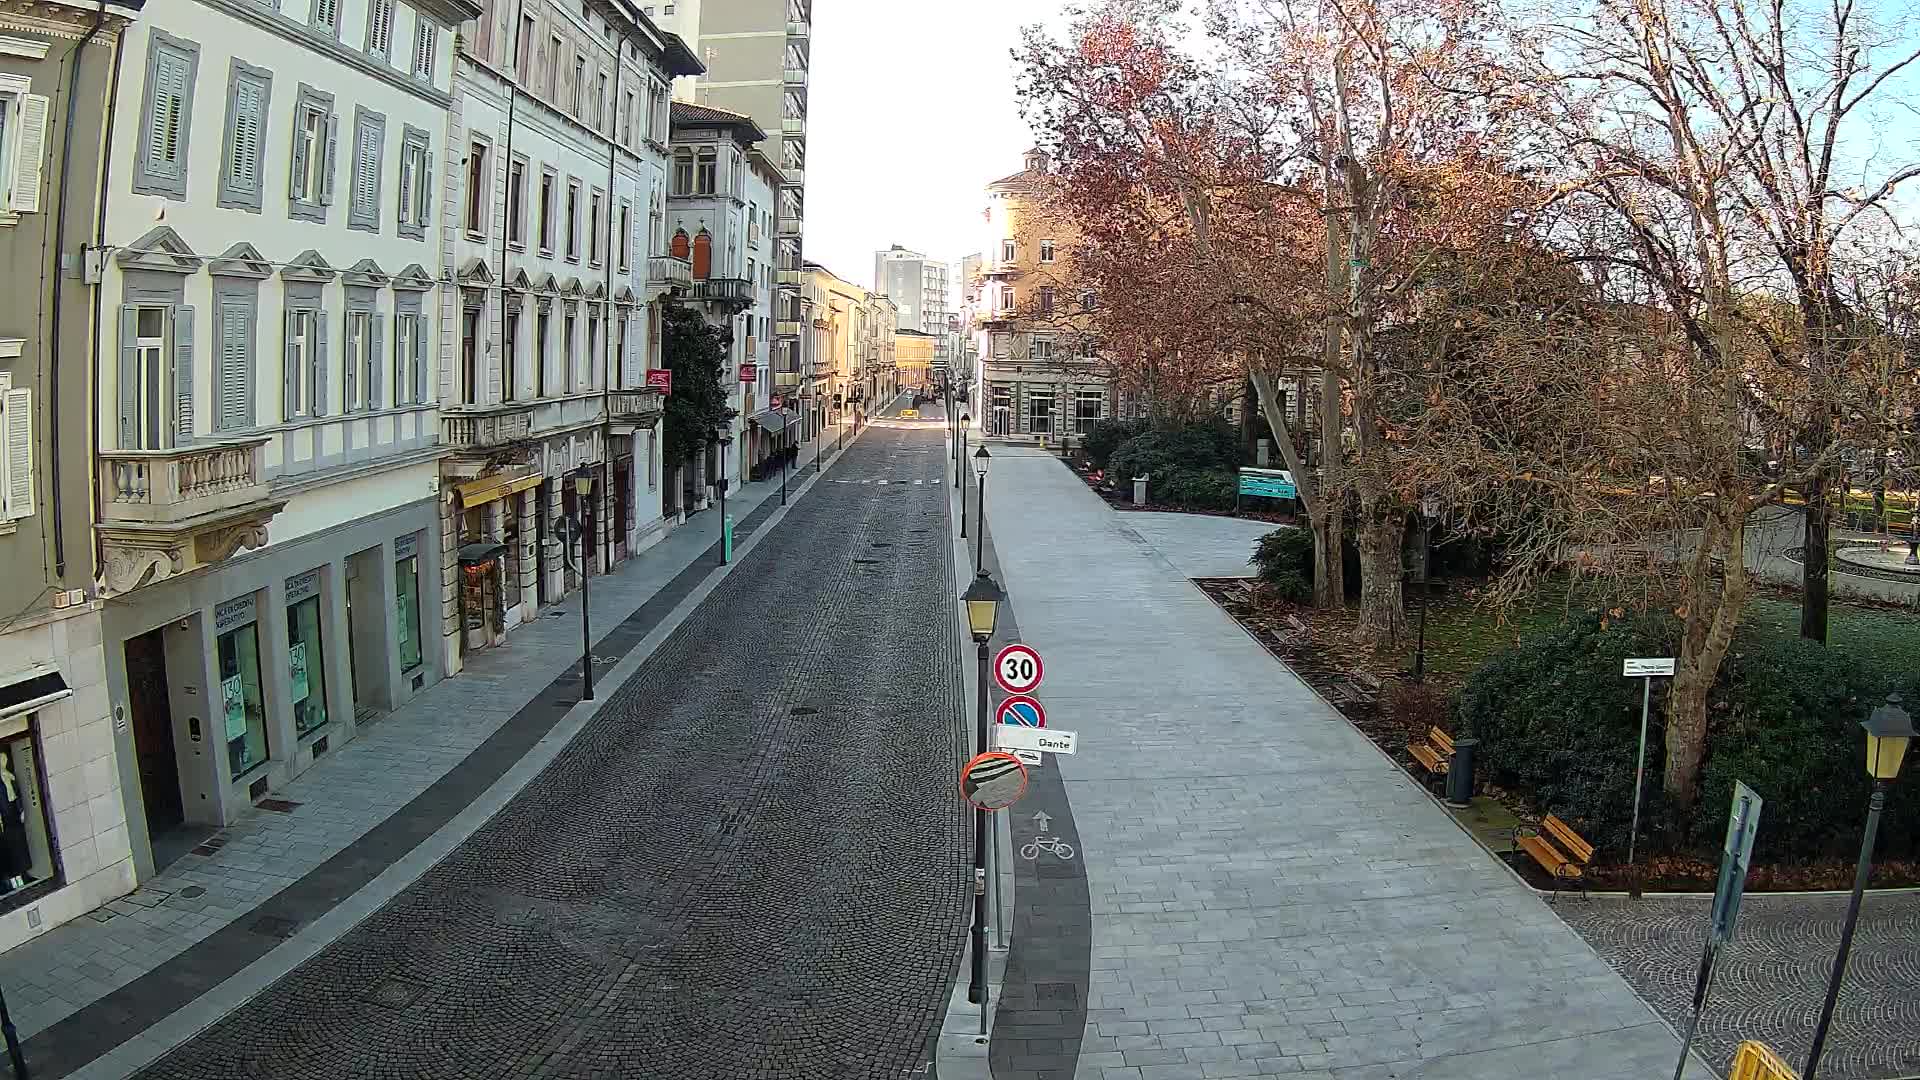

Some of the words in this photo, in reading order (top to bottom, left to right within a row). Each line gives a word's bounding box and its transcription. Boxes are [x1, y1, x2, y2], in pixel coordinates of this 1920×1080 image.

[1006, 658, 1033, 680] 30
[223, 678, 241, 699] 130
[1039, 738, 1070, 749] Dante
